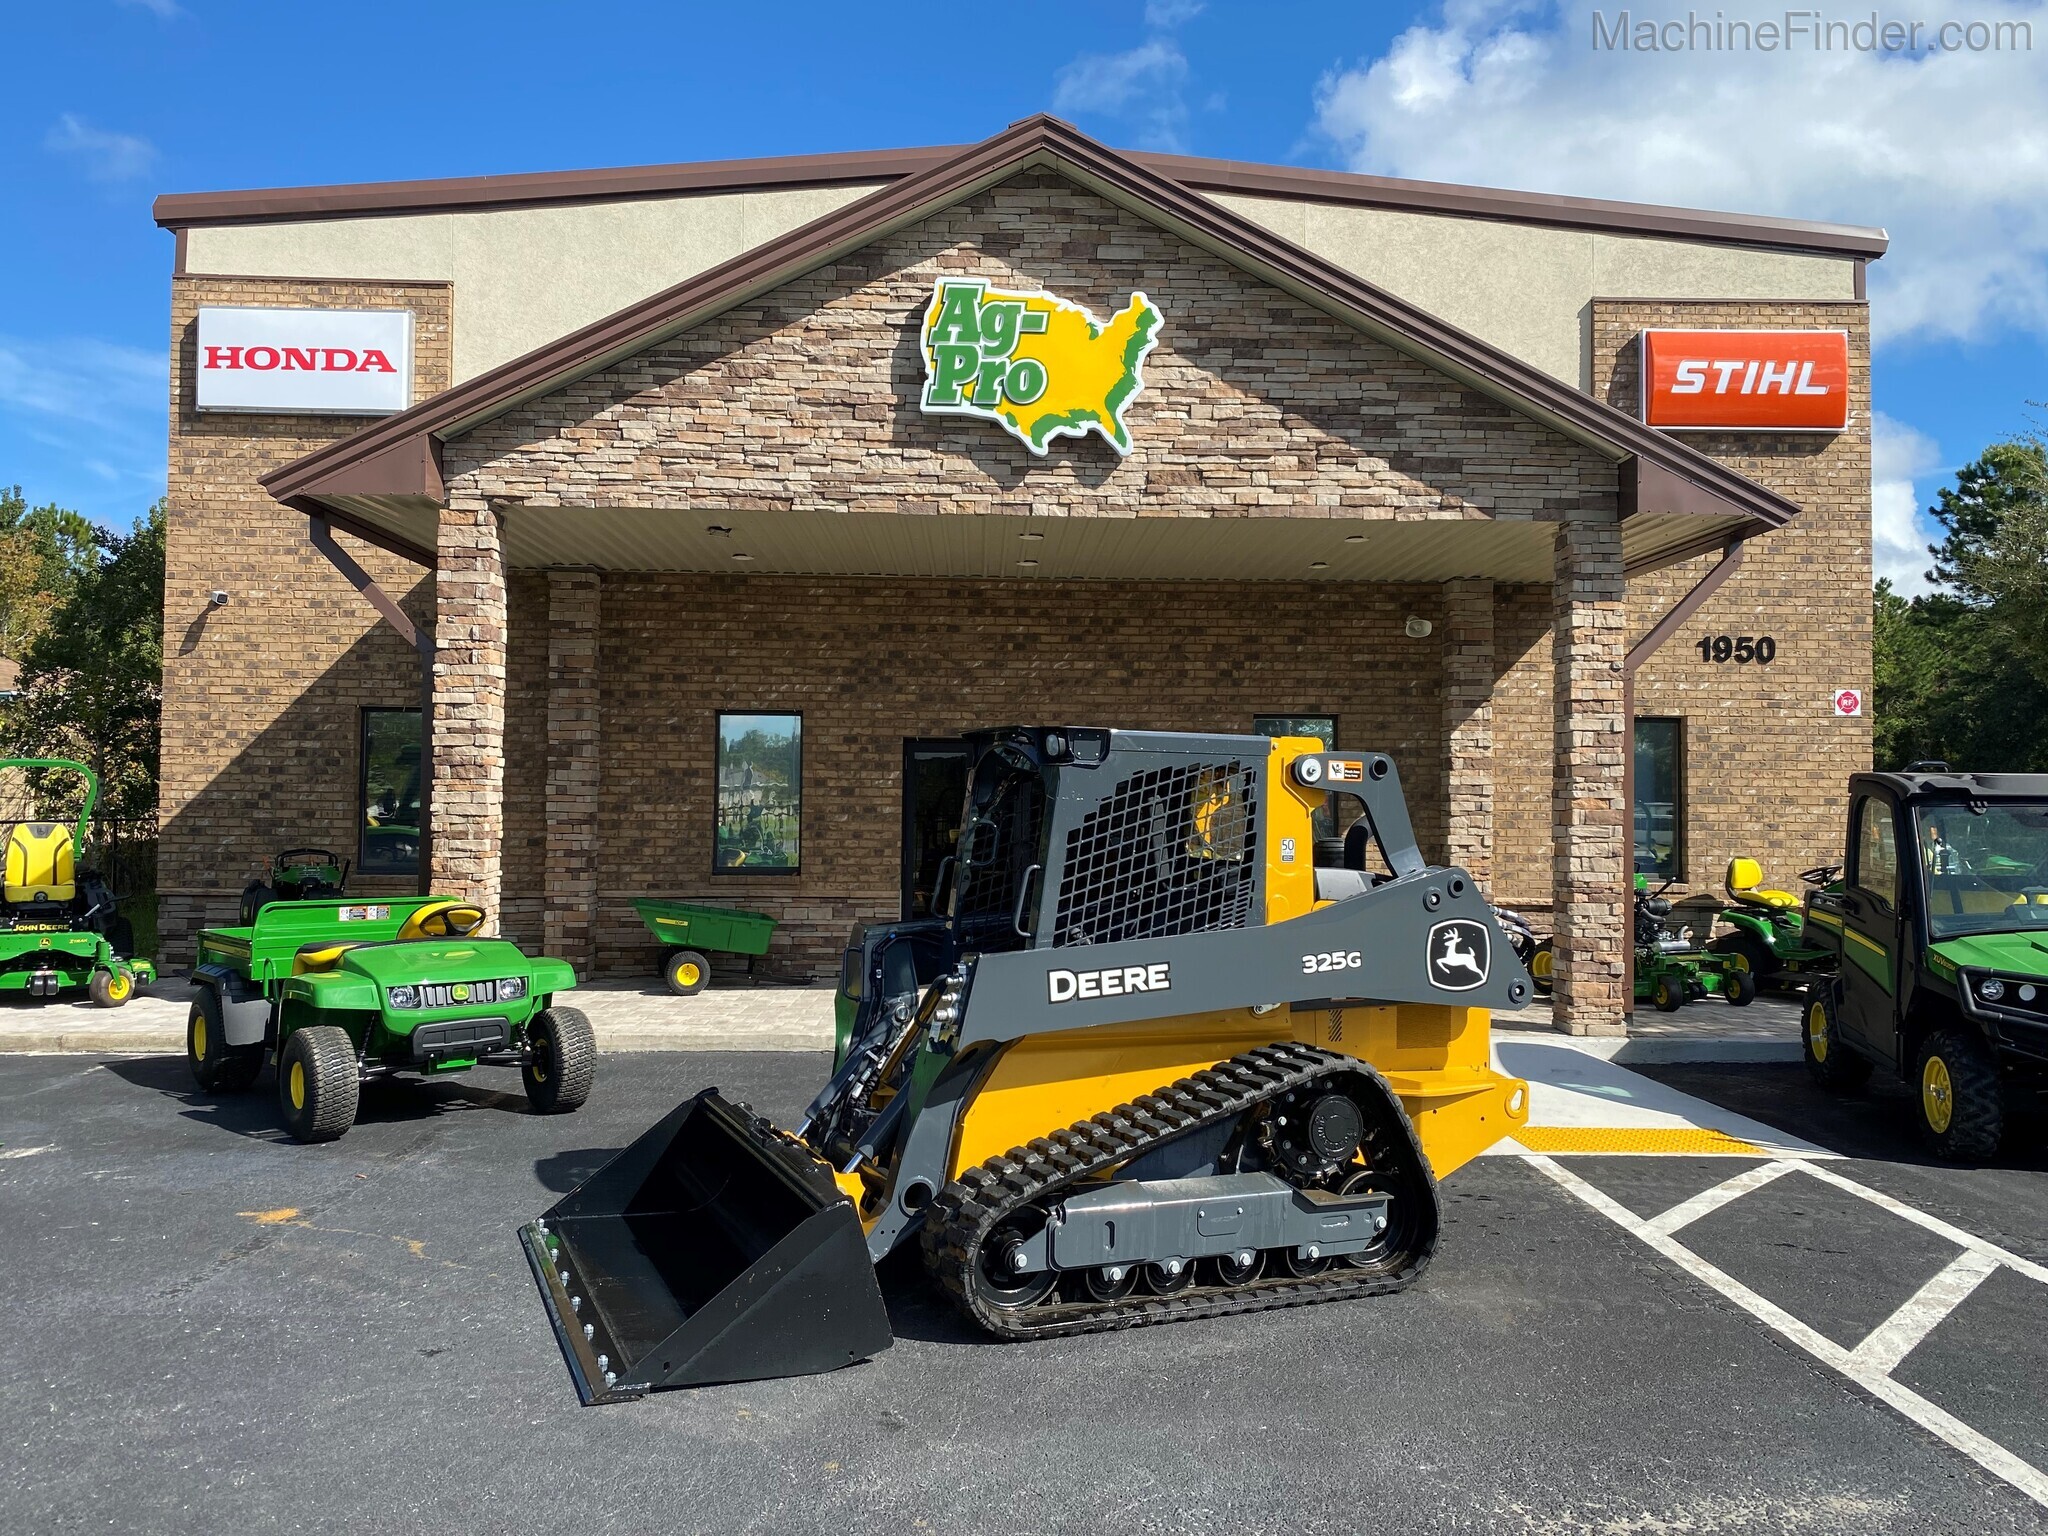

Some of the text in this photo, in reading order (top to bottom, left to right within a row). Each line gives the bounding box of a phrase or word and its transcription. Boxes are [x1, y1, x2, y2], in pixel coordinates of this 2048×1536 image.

[927, 282, 1050, 359] Ag-
[204, 346, 397, 373] HONDA
[926, 344, 1049, 406] Pro
[1671, 360, 1830, 395] STIHL
[1696, 635, 1776, 665] 1950
[1281, 839, 1294, 851] 50
[13, 923, 70, 932] JOHN DEERE
[1302, 950, 1362, 975] 325G
[1049, 963, 1170, 1003] DEERE
